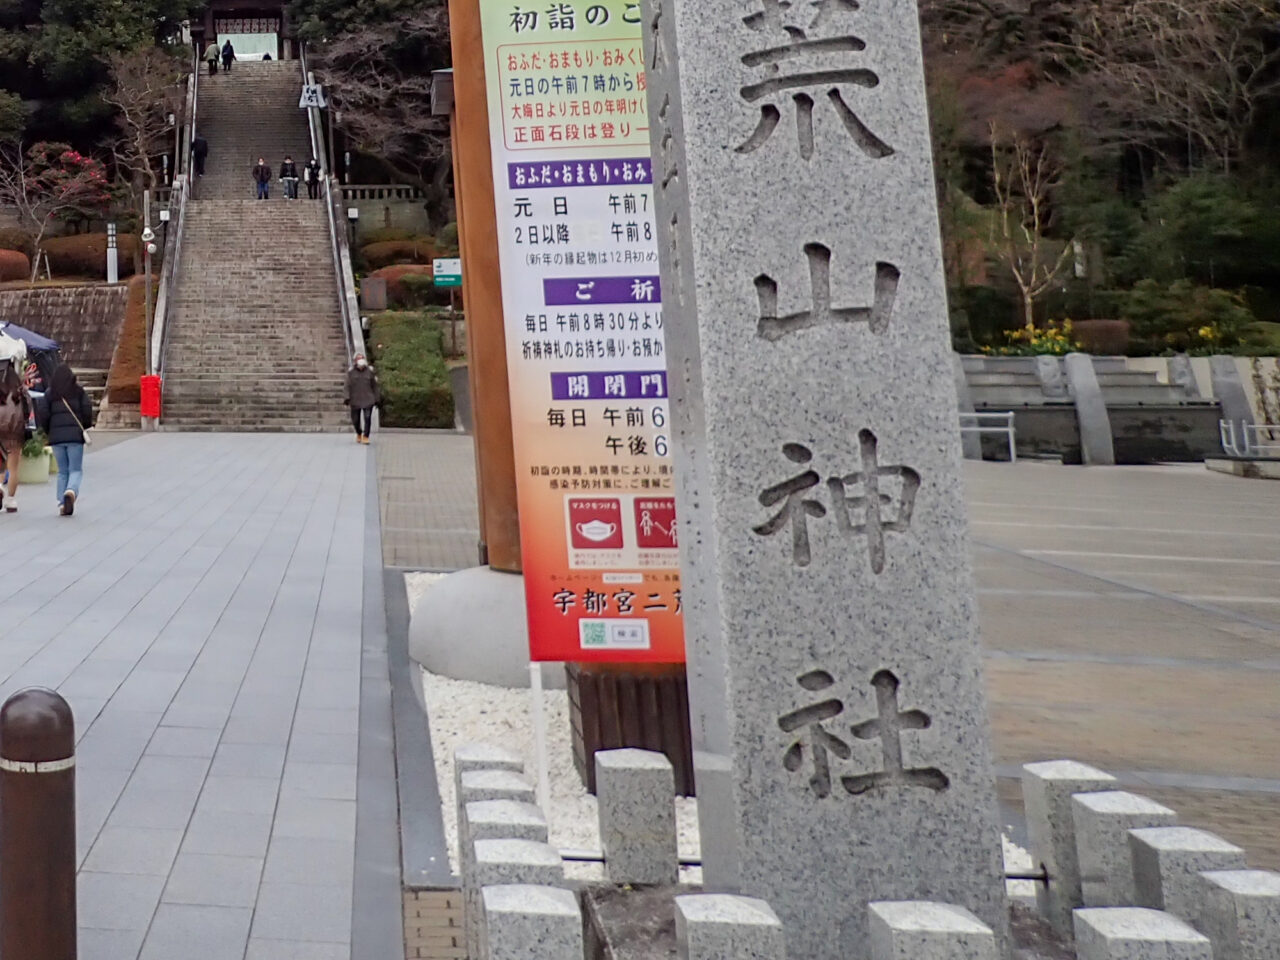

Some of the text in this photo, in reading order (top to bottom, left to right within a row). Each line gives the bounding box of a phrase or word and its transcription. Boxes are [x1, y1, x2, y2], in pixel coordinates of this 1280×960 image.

[609, 193, 648, 214] 午前7
[515, 221, 652, 245] 2日以降 午前8
[525, 314, 548, 333] 毎日
[568, 374, 663, 397] 開閉門
[547, 406, 665, 427] 毎日 午前6
[605, 435, 667, 456] 午後6
